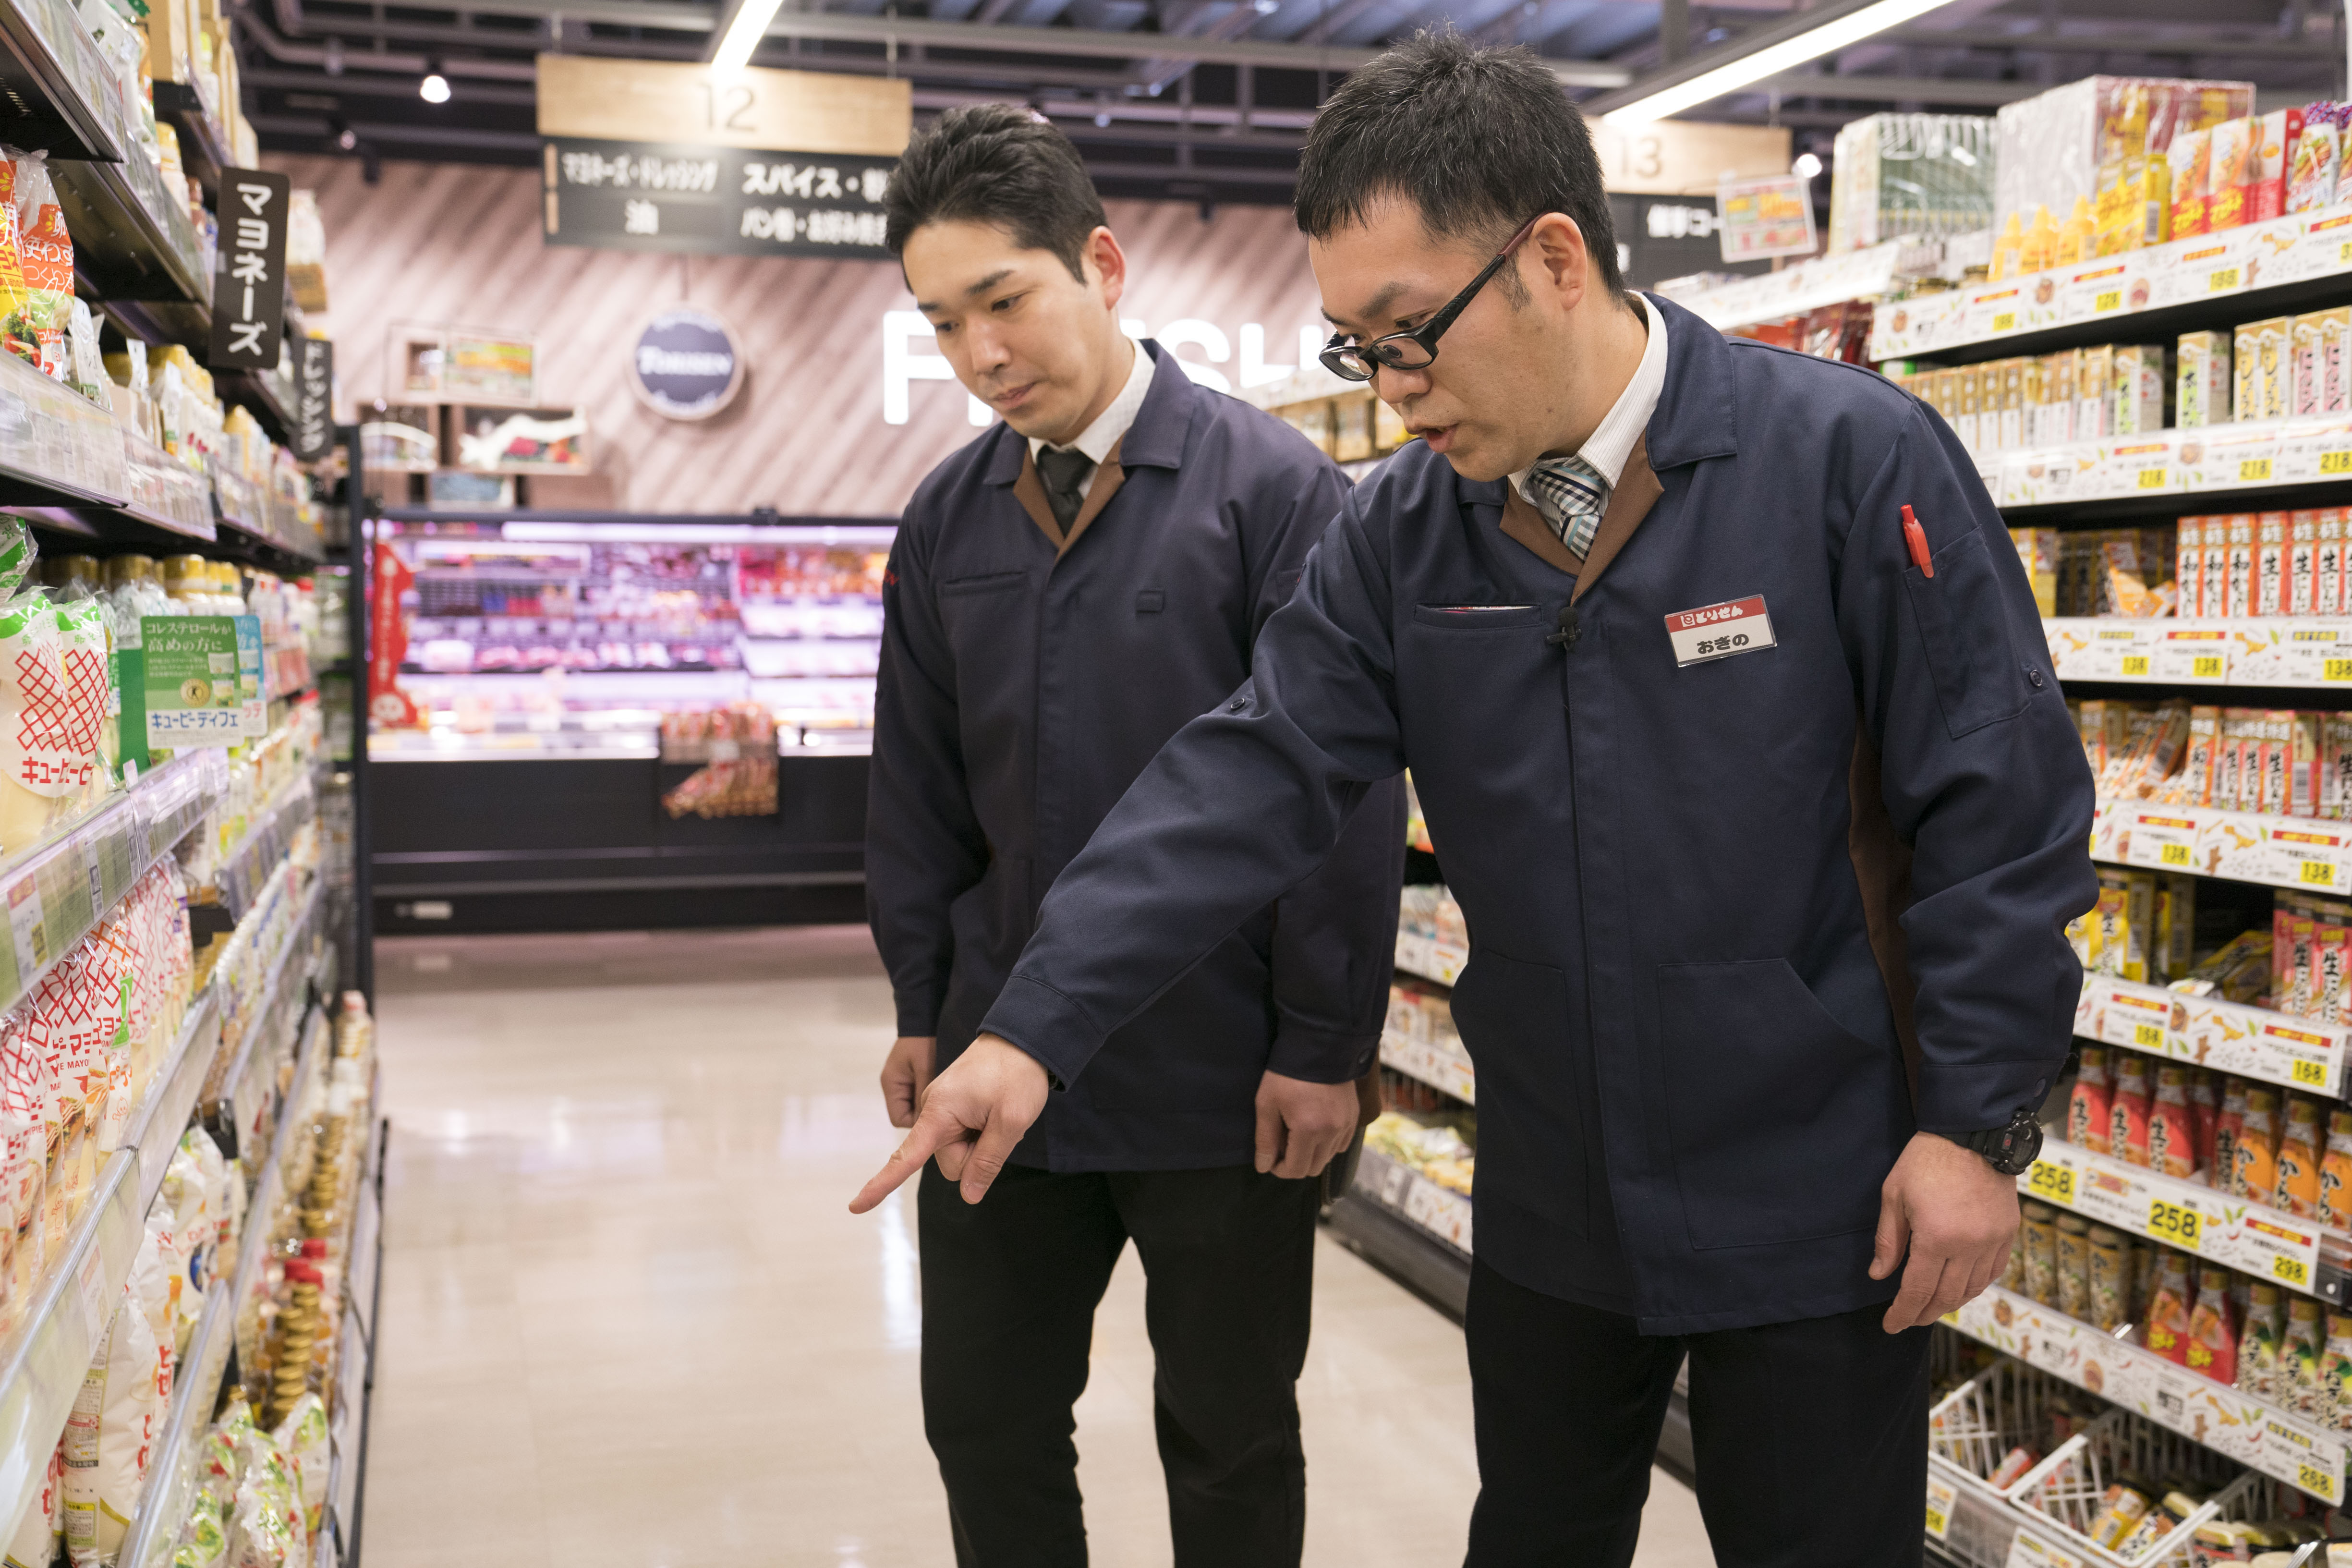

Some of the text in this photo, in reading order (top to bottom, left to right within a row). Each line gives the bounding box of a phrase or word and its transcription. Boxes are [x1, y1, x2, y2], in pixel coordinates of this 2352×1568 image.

[698, 80, 758, 133] 12
[1617, 134, 1663, 179] 13
[228, 182, 272, 356] マヨネーズ
[1696, 605, 1743, 624] とりせん
[146, 621, 231, 635] コレステロールが
[148, 637, 223, 653] 高めの方に
[1697, 634, 1749, 654] おぎの
[2305, 862, 2329, 880] 138
[67, 1058, 89, 1069] MAYO
[2032, 1162, 2071, 1193] 258
[2151, 1203, 2196, 1238] 258
